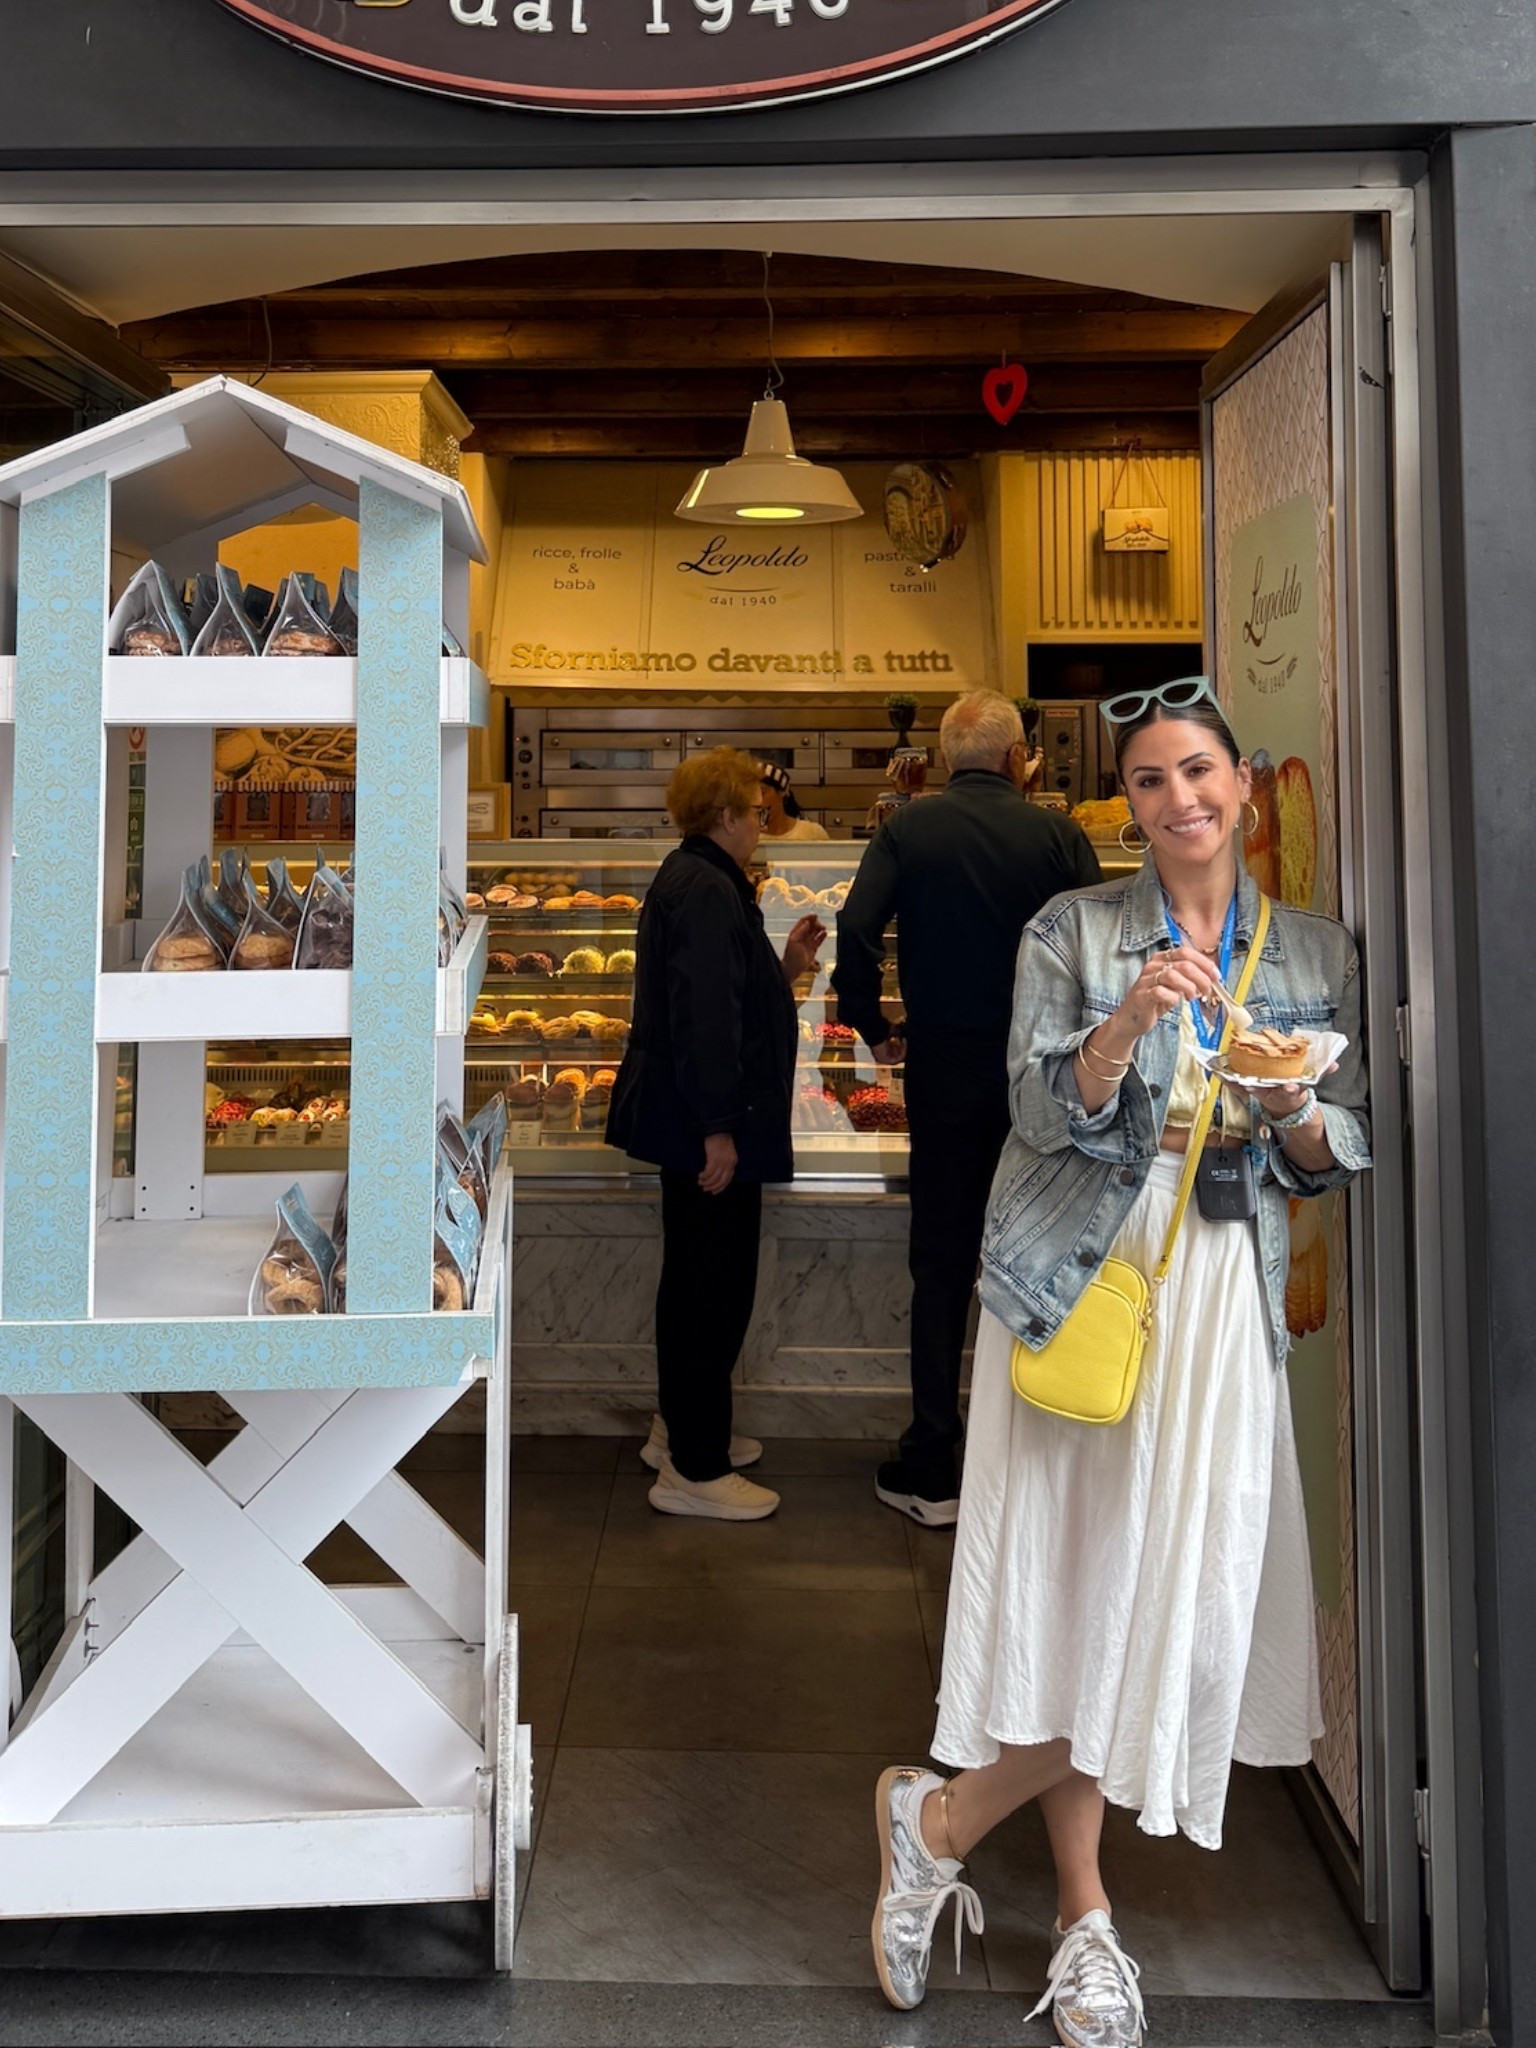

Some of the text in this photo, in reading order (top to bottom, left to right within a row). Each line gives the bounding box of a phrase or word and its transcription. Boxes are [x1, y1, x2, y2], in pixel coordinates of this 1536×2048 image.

[532, 546, 622, 559] ricce, frolle
[677, 535, 809, 576] Leopoldo
[568, 563, 579, 574] &
[904, 566, 915, 577] &
[553, 578, 596, 591] babà
[890, 581, 936, 593] taralli
[709, 595, 777, 606] dal 1940
[1243, 555, 1302, 648] Leopoldo
[510, 642, 953, 673] Sforniamo davanti a tutti
